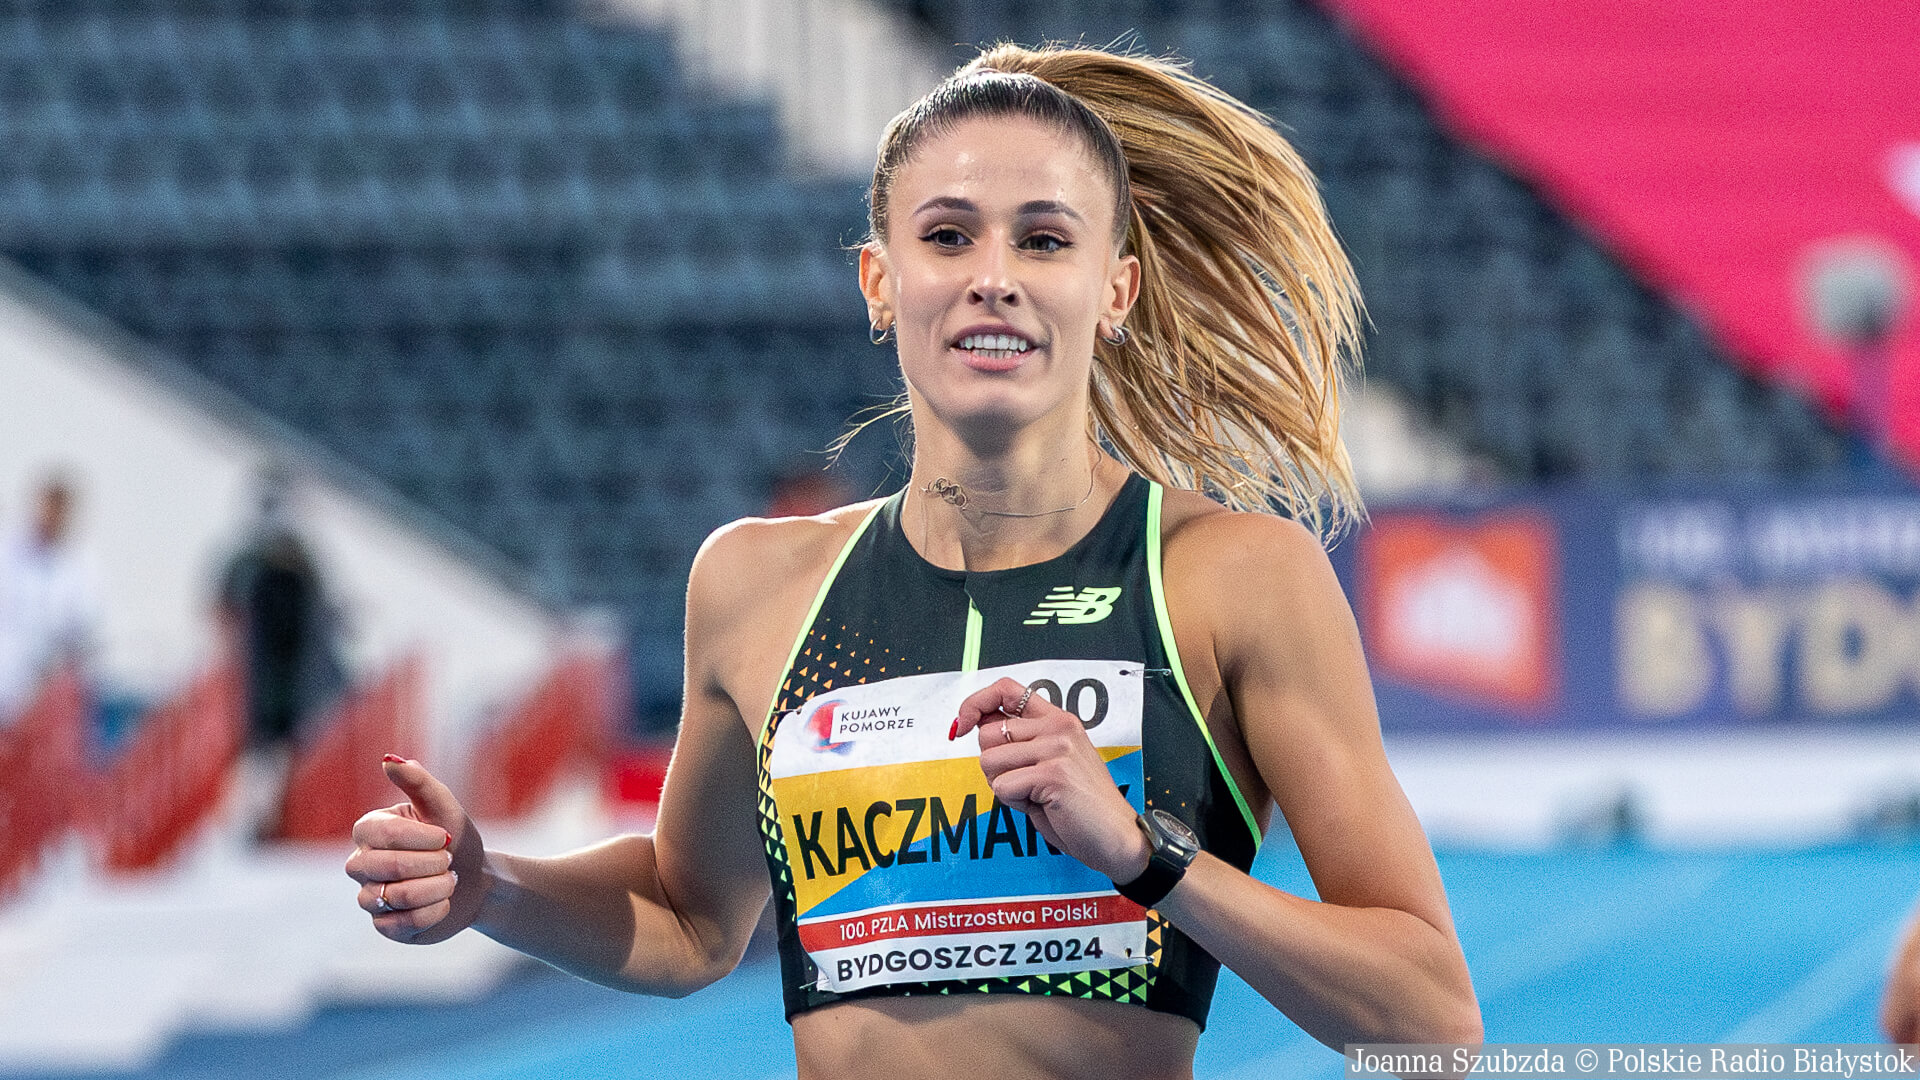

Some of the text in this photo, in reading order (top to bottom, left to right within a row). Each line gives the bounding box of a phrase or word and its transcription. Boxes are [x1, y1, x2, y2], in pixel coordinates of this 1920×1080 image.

[1615, 576, 1920, 718] BYD
[839, 718, 914, 733] POMORZE
[841, 706, 901, 722] KUJAWY
[792, 784, 1130, 880] KACZMA
[840, 902, 1098, 941] 100. PZLA Mistrzostwa Polski
[837, 936, 1103, 982] BYDGOSZCZ 2024
